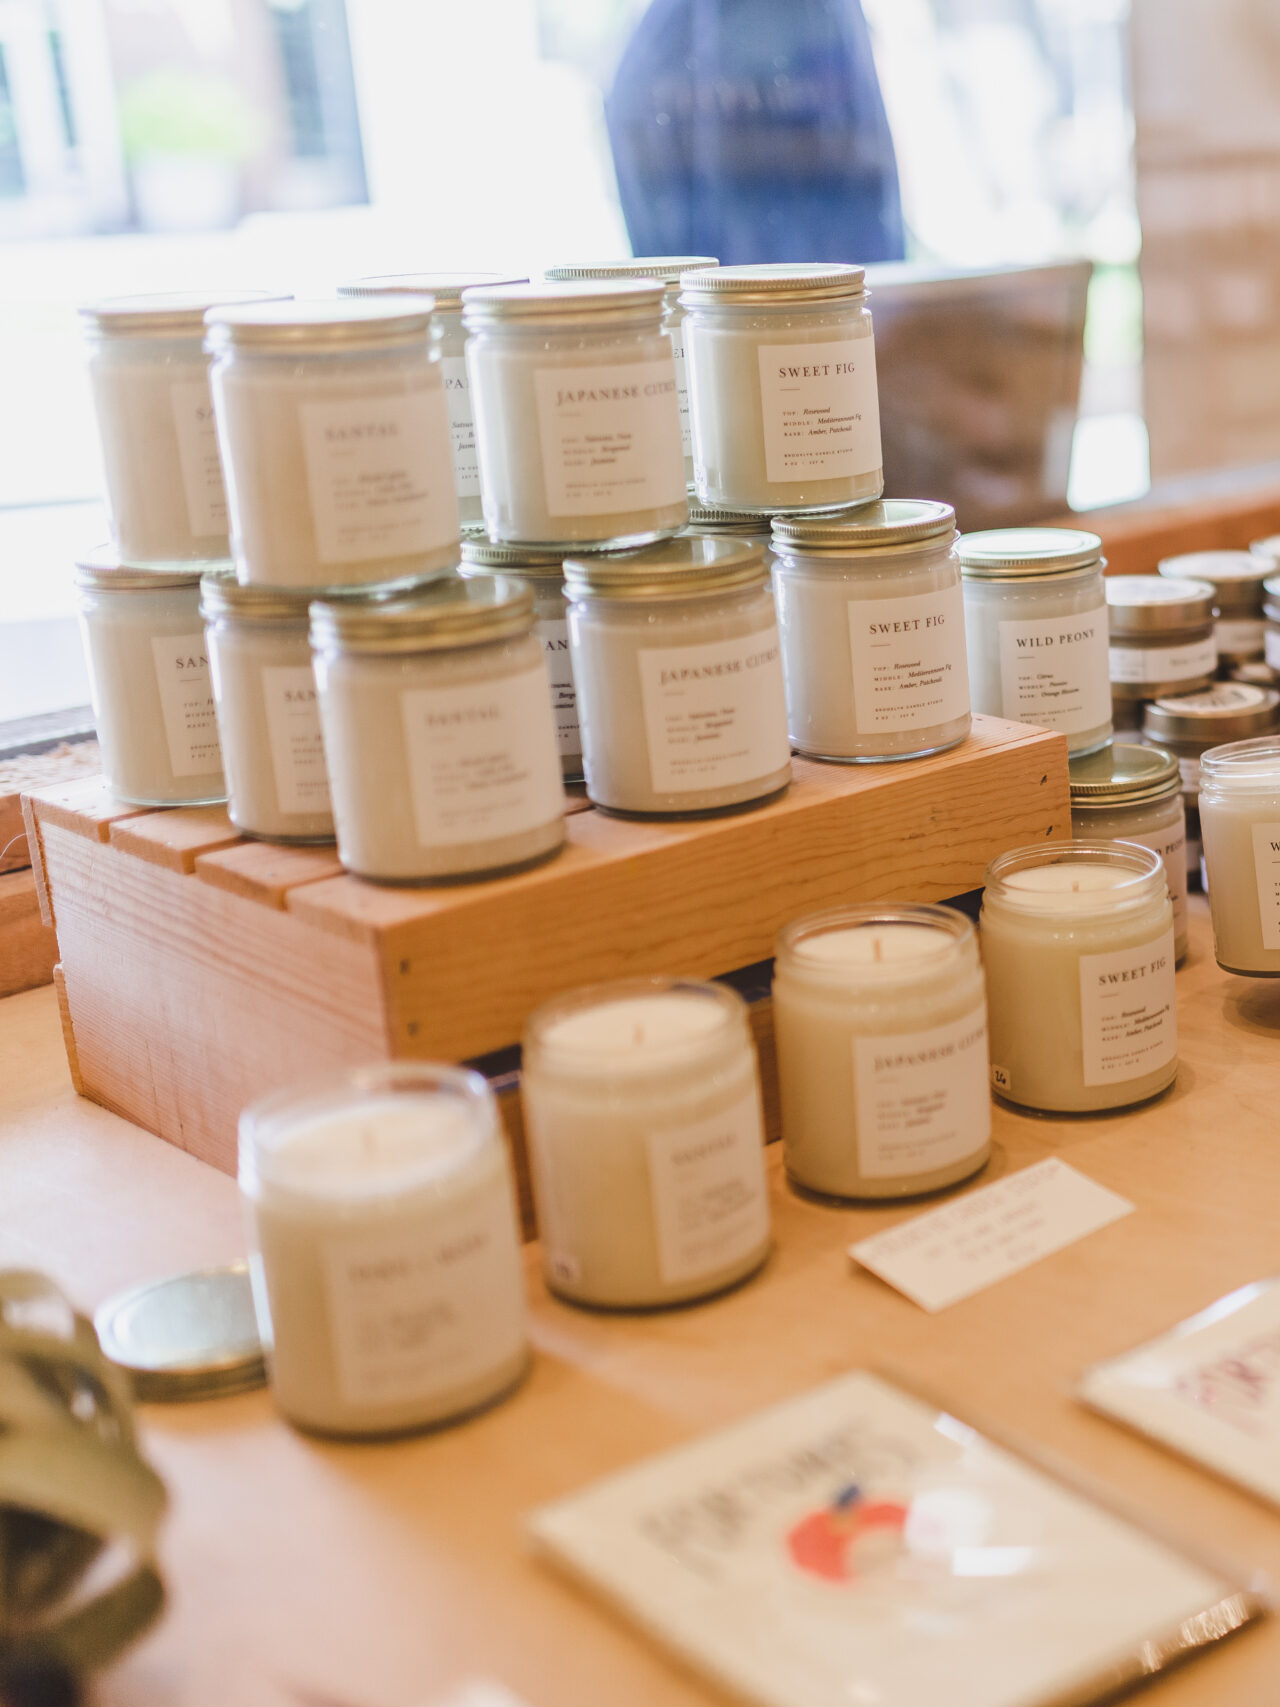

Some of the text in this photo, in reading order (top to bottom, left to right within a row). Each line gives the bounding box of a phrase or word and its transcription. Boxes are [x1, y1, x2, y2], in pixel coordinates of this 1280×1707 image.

[779, 362, 855, 379] SWEET FIG
[556, 386, 638, 406] JAPANESE
[869, 615, 945, 635] SWEET FIG
[1016, 629, 1095, 648] WILD PEONY
[659, 660, 741, 686] JAPANESE
[1098, 957, 1166, 986] SWEET FIG
